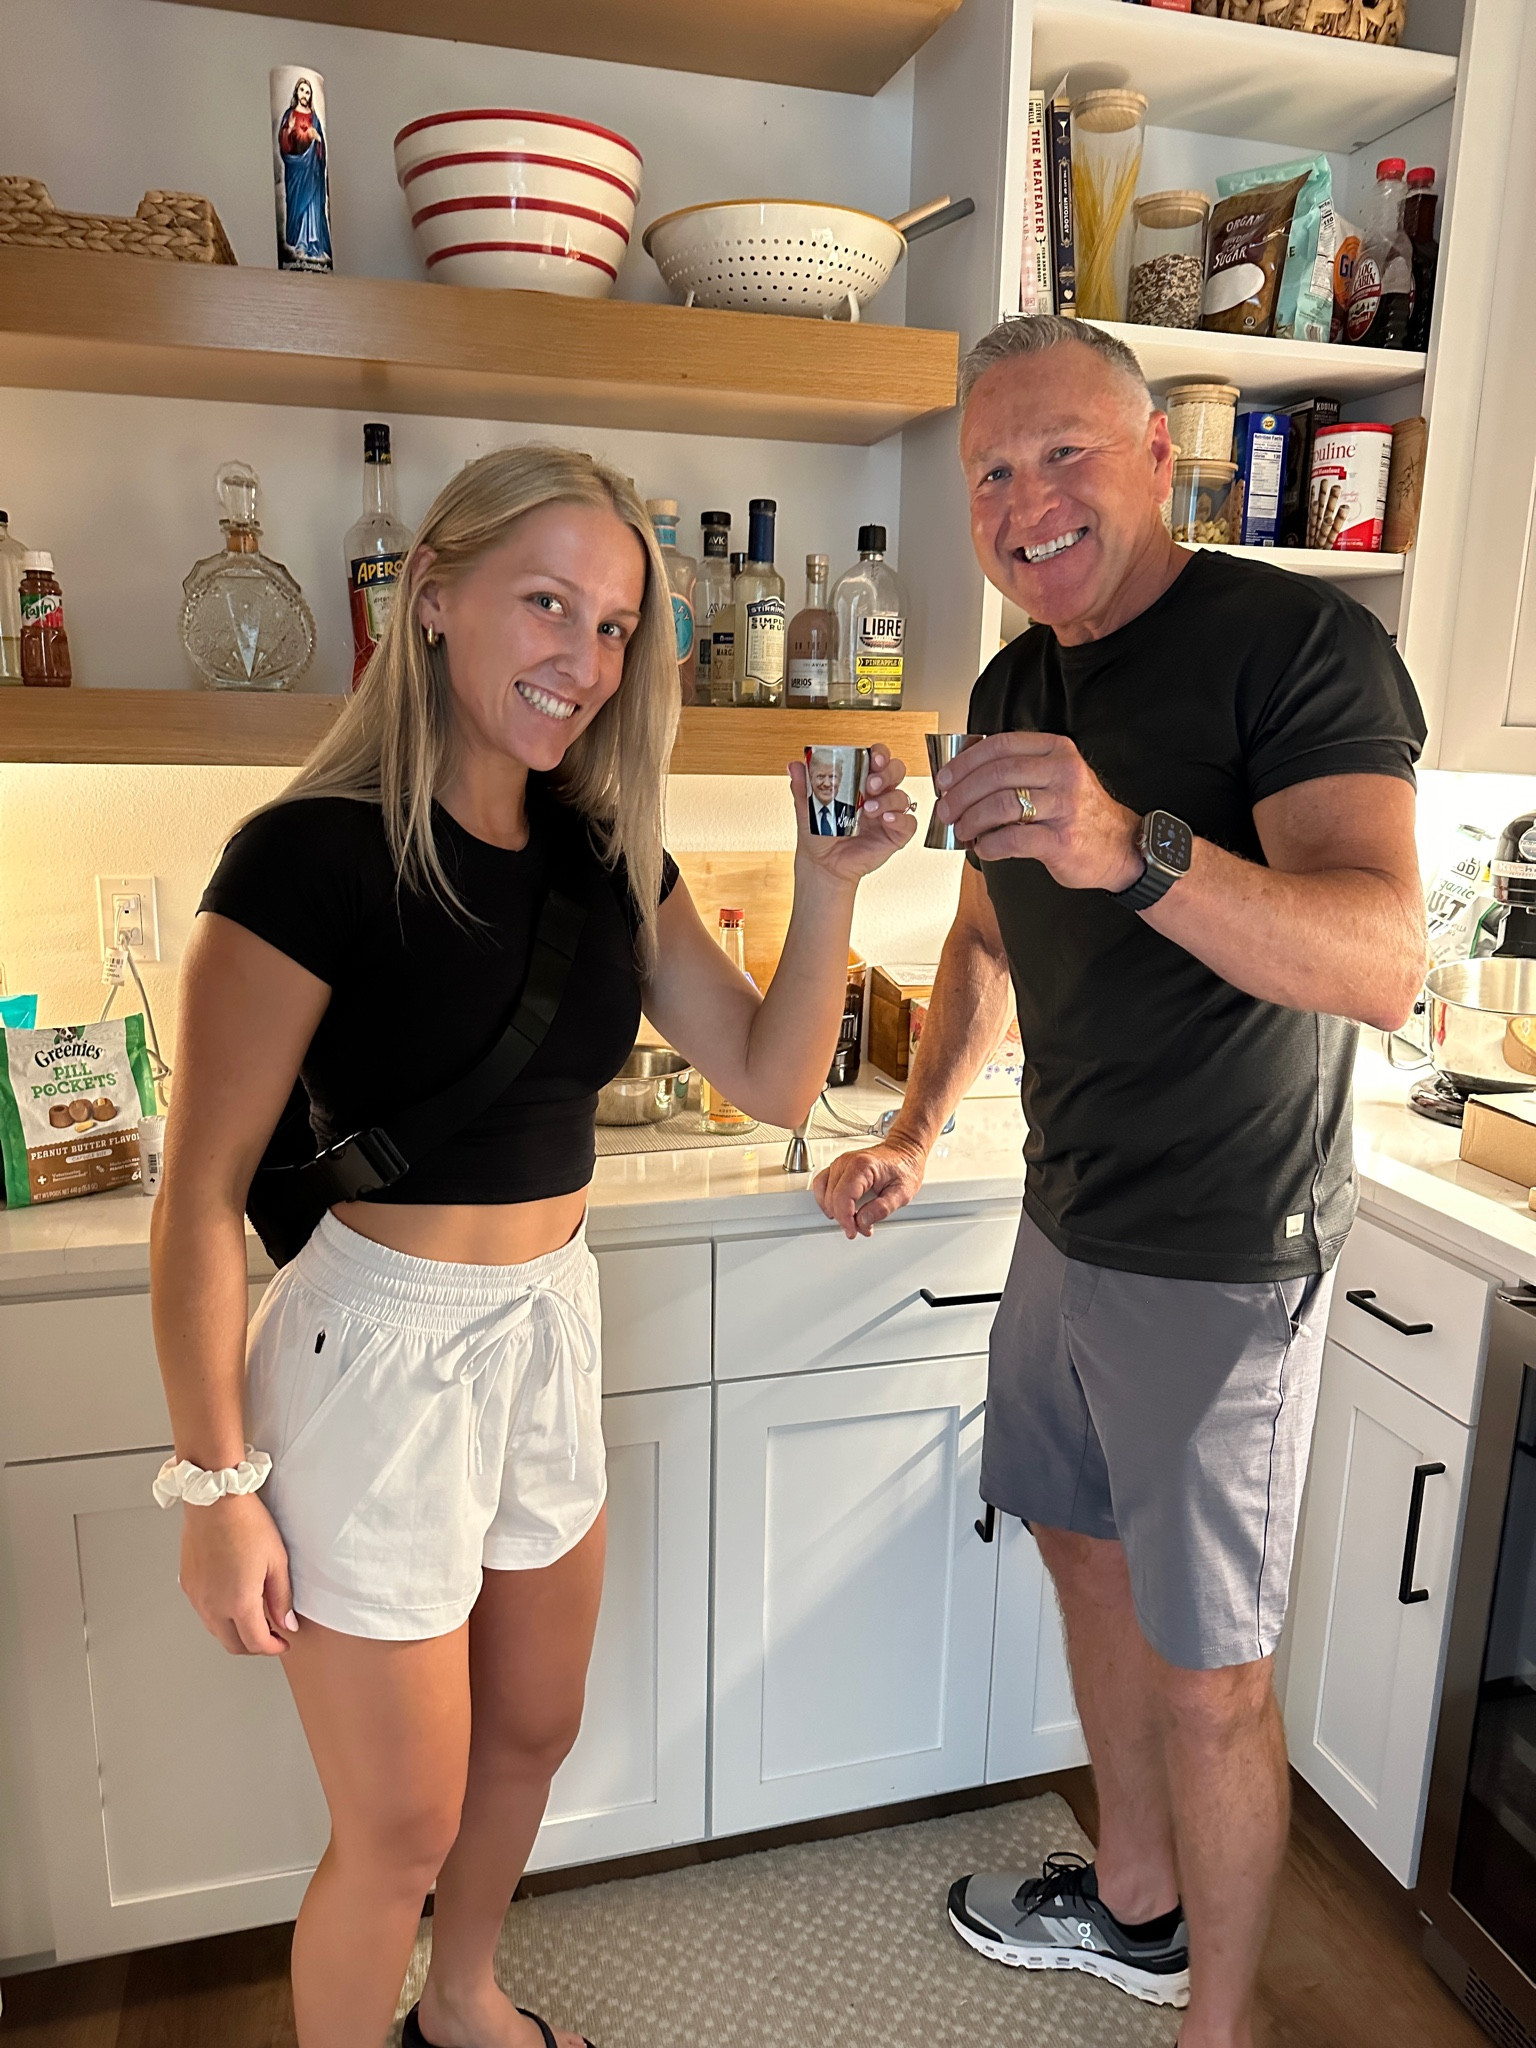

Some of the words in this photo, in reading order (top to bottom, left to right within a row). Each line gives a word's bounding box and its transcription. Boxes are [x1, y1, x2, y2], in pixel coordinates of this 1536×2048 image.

[1031, 130, 1041, 154] THE
[1032, 159, 1045, 234] MEATEATER
[1213, 245, 1248, 270] SUGAR
[1358, 261, 1374, 277] LOG
[1353, 272, 1377, 293] CABIN
[1316, 402, 1338, 413] KODIAK
[862, 617, 902, 637] LIBRE
[864, 658, 898, 667] PINEAPPLE
[791, 677, 812, 688] LARIOS
[34, 1040, 103, 1068] Greenies
[52, 1063, 92, 1081] PILL
[30, 1073, 117, 1099] POCKETS
[30, 1146, 69, 1161] PEANUT
[71, 1139, 107, 1154] BUTTER
